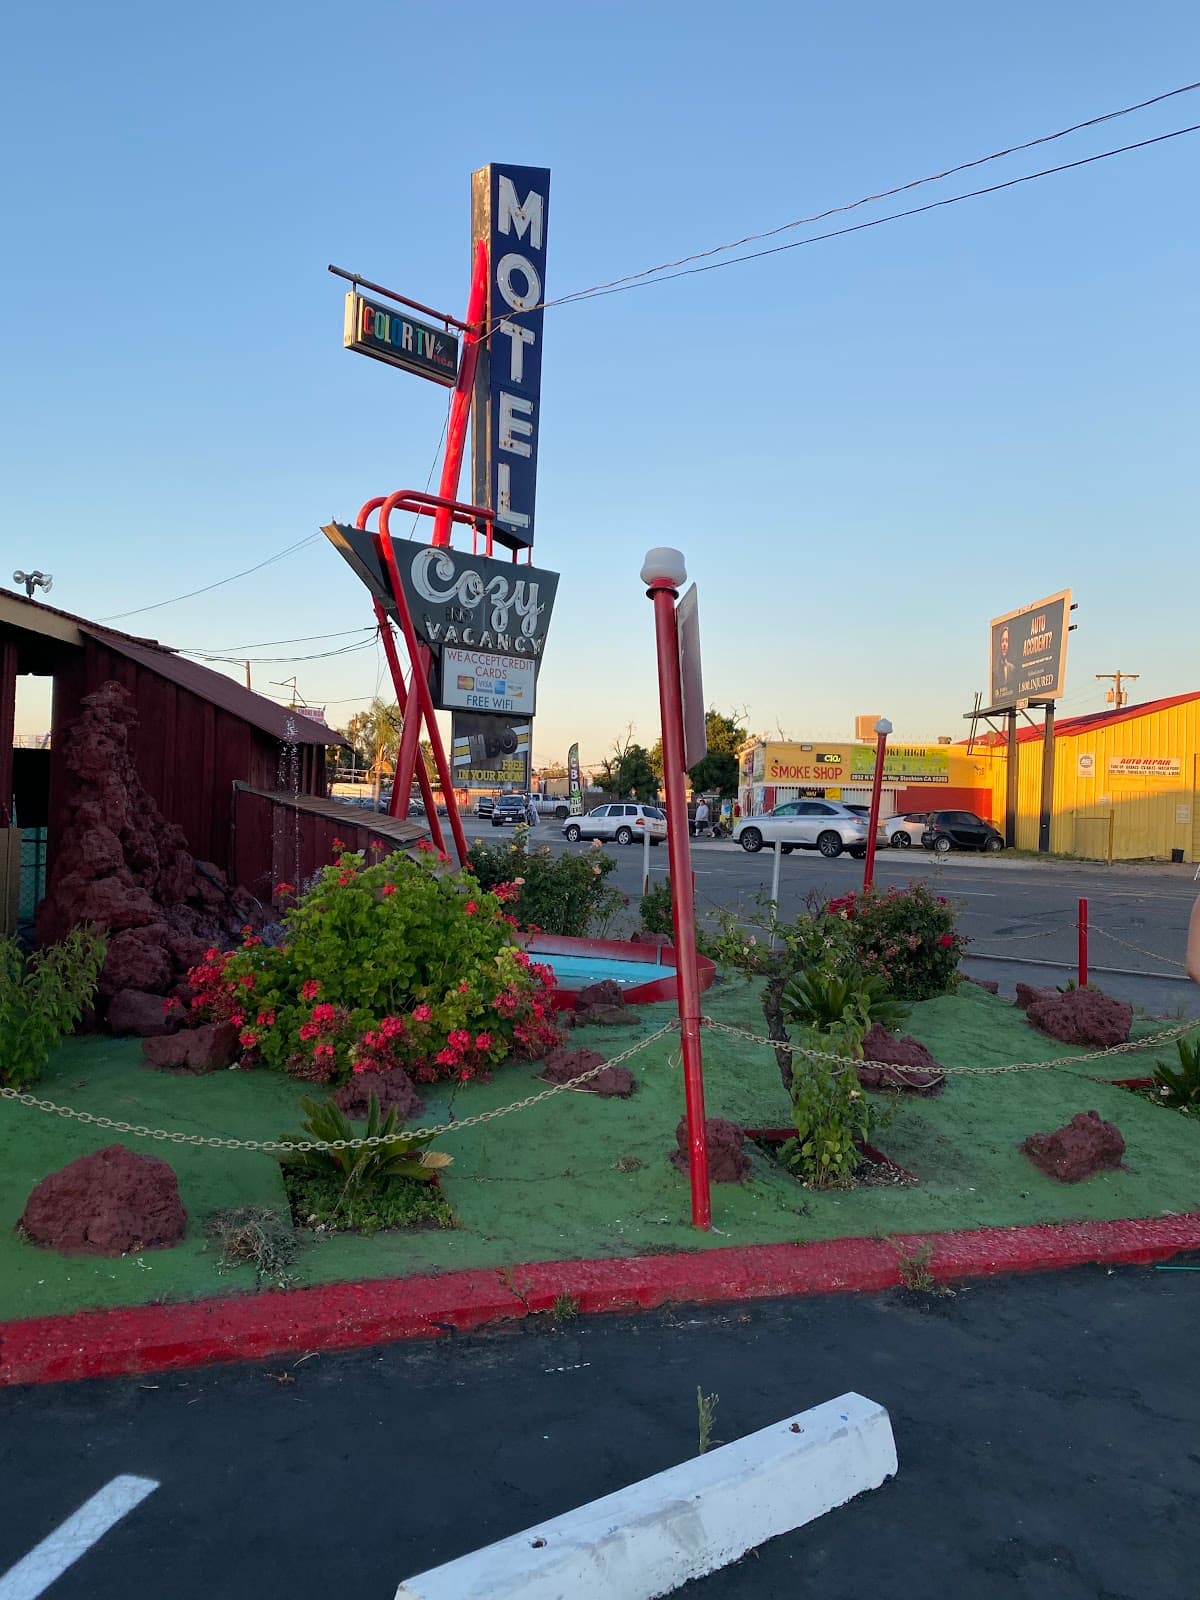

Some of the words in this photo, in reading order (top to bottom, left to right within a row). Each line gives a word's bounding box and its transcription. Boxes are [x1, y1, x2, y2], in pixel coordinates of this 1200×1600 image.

[363, 305, 414, 353] COLOR
[416, 327, 436, 360] TV
[497, 174, 544, 530] MOTEL
[411, 548, 545, 638] Cozy
[1031, 614, 1046, 635] AUTO
[425, 620, 545, 655] VACANCY
[447, 650, 463, 662] WE
[464, 652, 500, 667] ACCEPT
[501, 657, 534, 671] CREDIT
[475, 666, 508, 680] CARDS
[479, 680, 493, 688] VISA
[466, 694, 489, 708] FREE
[904, 748, 926, 757] HIGH
[502, 759, 525, 770] FREE
[458, 769, 469, 780] IN
[471, 769, 496, 781] YOUR
[497, 770, 525, 782] ROOM
[771, 766, 810, 779] SMOKE
[813, 766, 843, 780] SHOP
